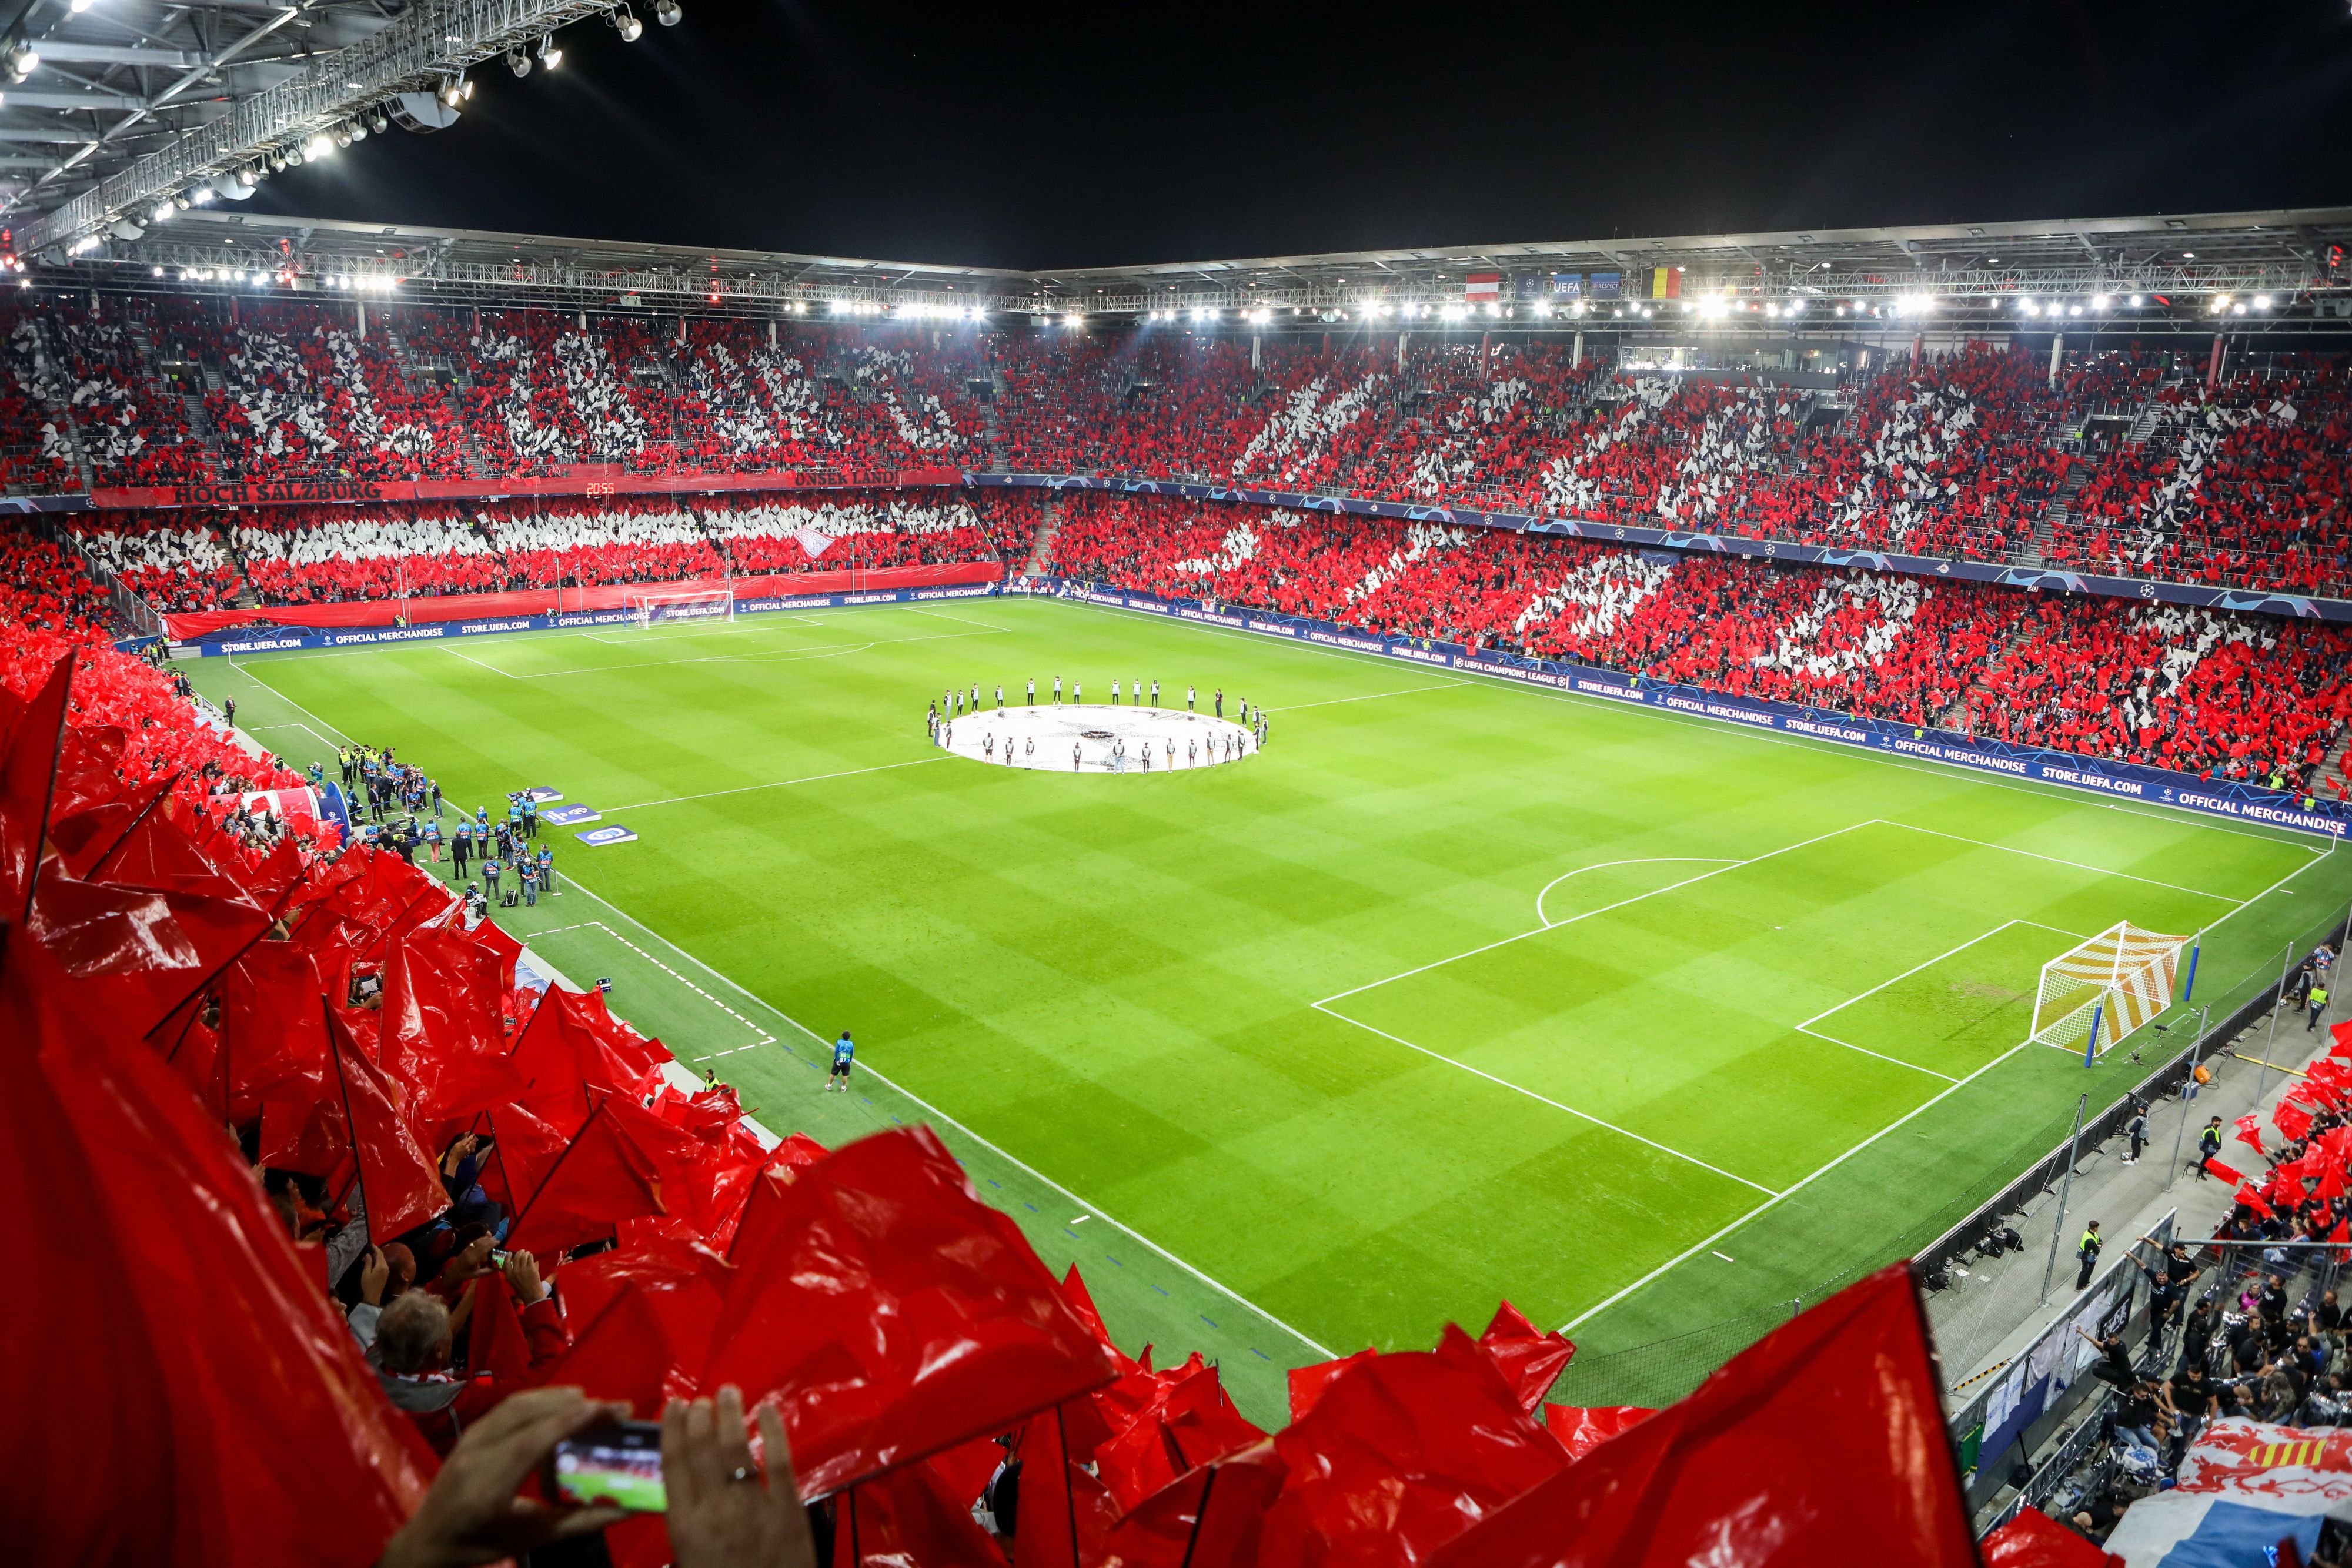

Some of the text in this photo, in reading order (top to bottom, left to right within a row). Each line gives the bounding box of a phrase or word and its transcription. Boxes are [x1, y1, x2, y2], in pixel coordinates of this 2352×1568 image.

[1554, 282, 1579, 292] UEFA
[853, 471, 898, 484] LAND!
[175, 482, 382, 503] HOCH SALZBURG
[586, 482, 614, 494] 20:55
[844, 594, 896, 604] STORE.UEFA.COM
[918, 590, 945, 600] OFFICIAL
[1090, 593, 1122, 605] MERCHANDISE
[667, 606, 724, 617] STORE.UEFA.COM
[750, 601, 780, 611] OFFICIAL
[781, 599, 831, 610] MERCHANDISE
[1129, 600, 1168, 613] STORE.UEFA.COM
[559, 616, 594, 626] OFFICIAL
[1181, 609, 1242, 627] OFFICIAL MERCHANDISE
[462, 621, 530, 634] STORE.UEFA.COM
[1249, 621, 1294, 636] STORE.UEFA.COM
[335, 632, 377, 644] OFFICIAL
[378, 627, 443, 641] MERCHANDISE
[1311, 632, 1383, 653] OFFICIAL MERCHANDISE
[221, 638, 302, 653] STORE.UEFA.COM
[1392, 646, 1446, 664] STORE.UEFA.COM
[1464, 660, 1556, 684] UEFA CHAMPIONS LEAGUE
[1577, 680, 1643, 700] STORE.UEFA.COM
[1666, 697, 1774, 726] OFFICIAL MERCHANDISE
[1786, 718, 1866, 743] STORE.UEFA.COM
[1895, 739, 2027, 774] OFFICIAL MERCHANDISE
[2042, 766, 2143, 795] STORE.UEFA.COM
[2179, 793, 2347, 835] OFFICIAL MERCHANDISE
